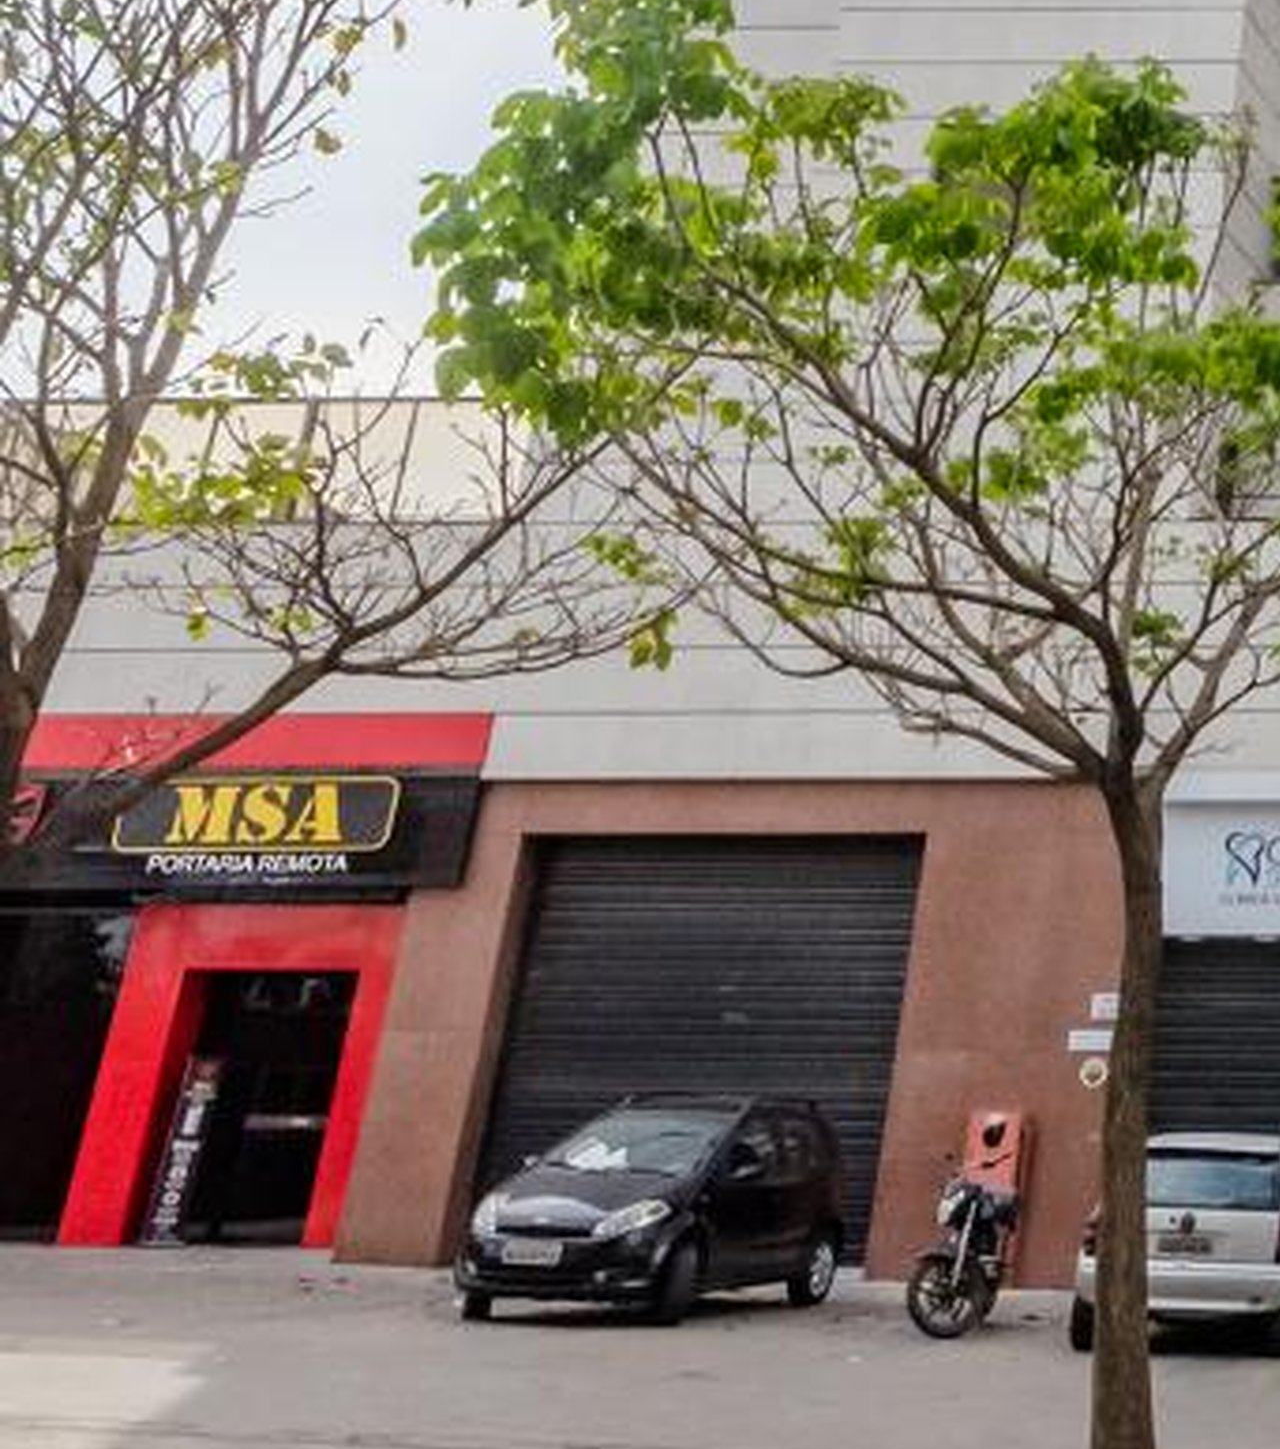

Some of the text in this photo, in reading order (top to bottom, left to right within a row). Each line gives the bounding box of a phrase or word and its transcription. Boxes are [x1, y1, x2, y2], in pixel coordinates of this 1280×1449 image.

[164, 781, 342, 844] MSA
[146, 854, 347, 874] PORTARIA REMOTA
